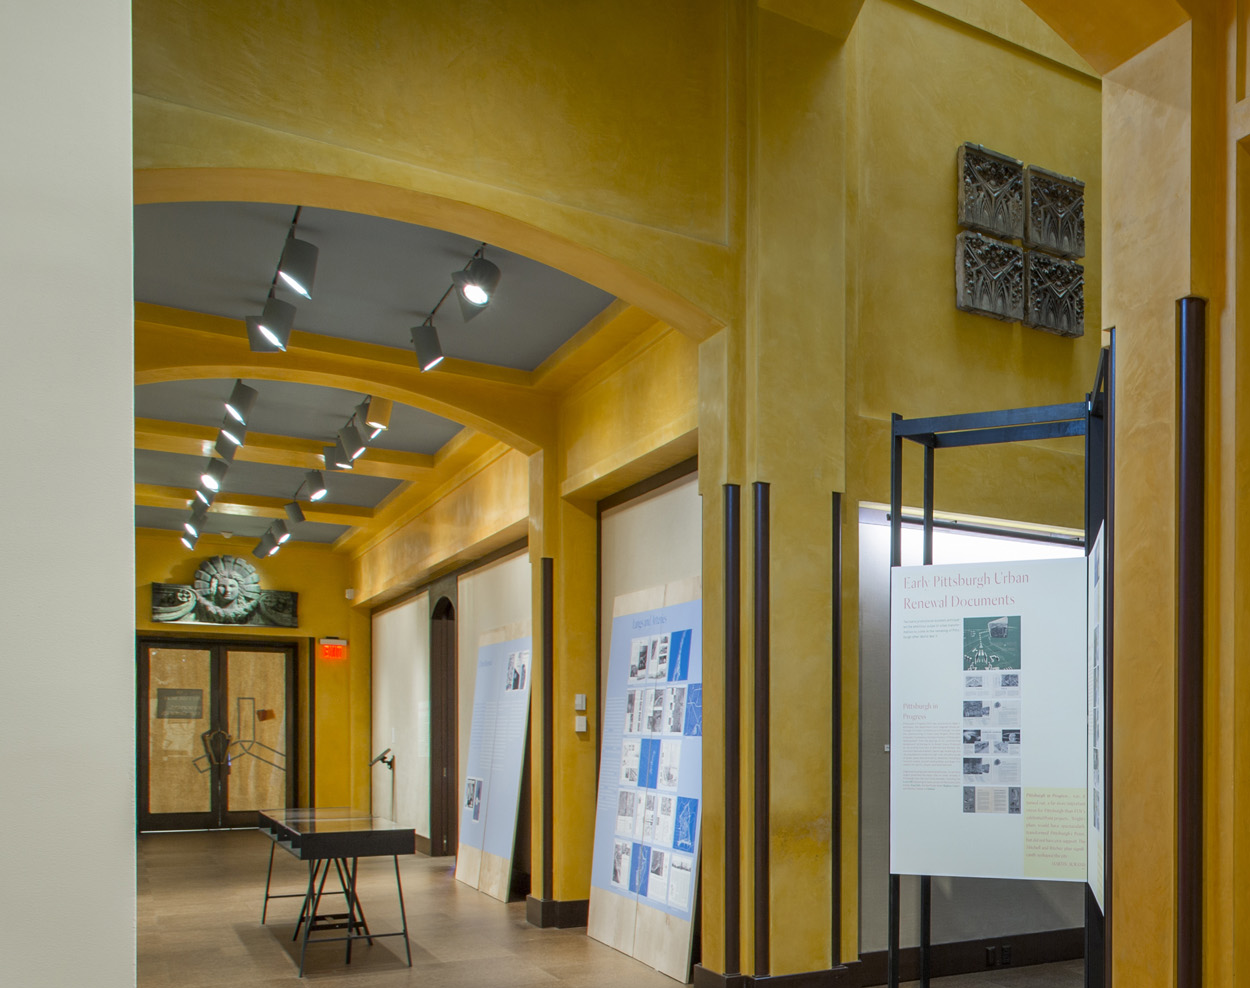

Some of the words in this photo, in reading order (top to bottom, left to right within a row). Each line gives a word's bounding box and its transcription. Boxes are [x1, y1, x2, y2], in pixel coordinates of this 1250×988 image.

[903, 576, 930, 592] Early
[933, 572, 991, 590] Pittsburgh
[994, 571, 1029, 586] Urban
[903, 595, 949, 610] Renewal
[951, 593, 1015, 608] Documents
